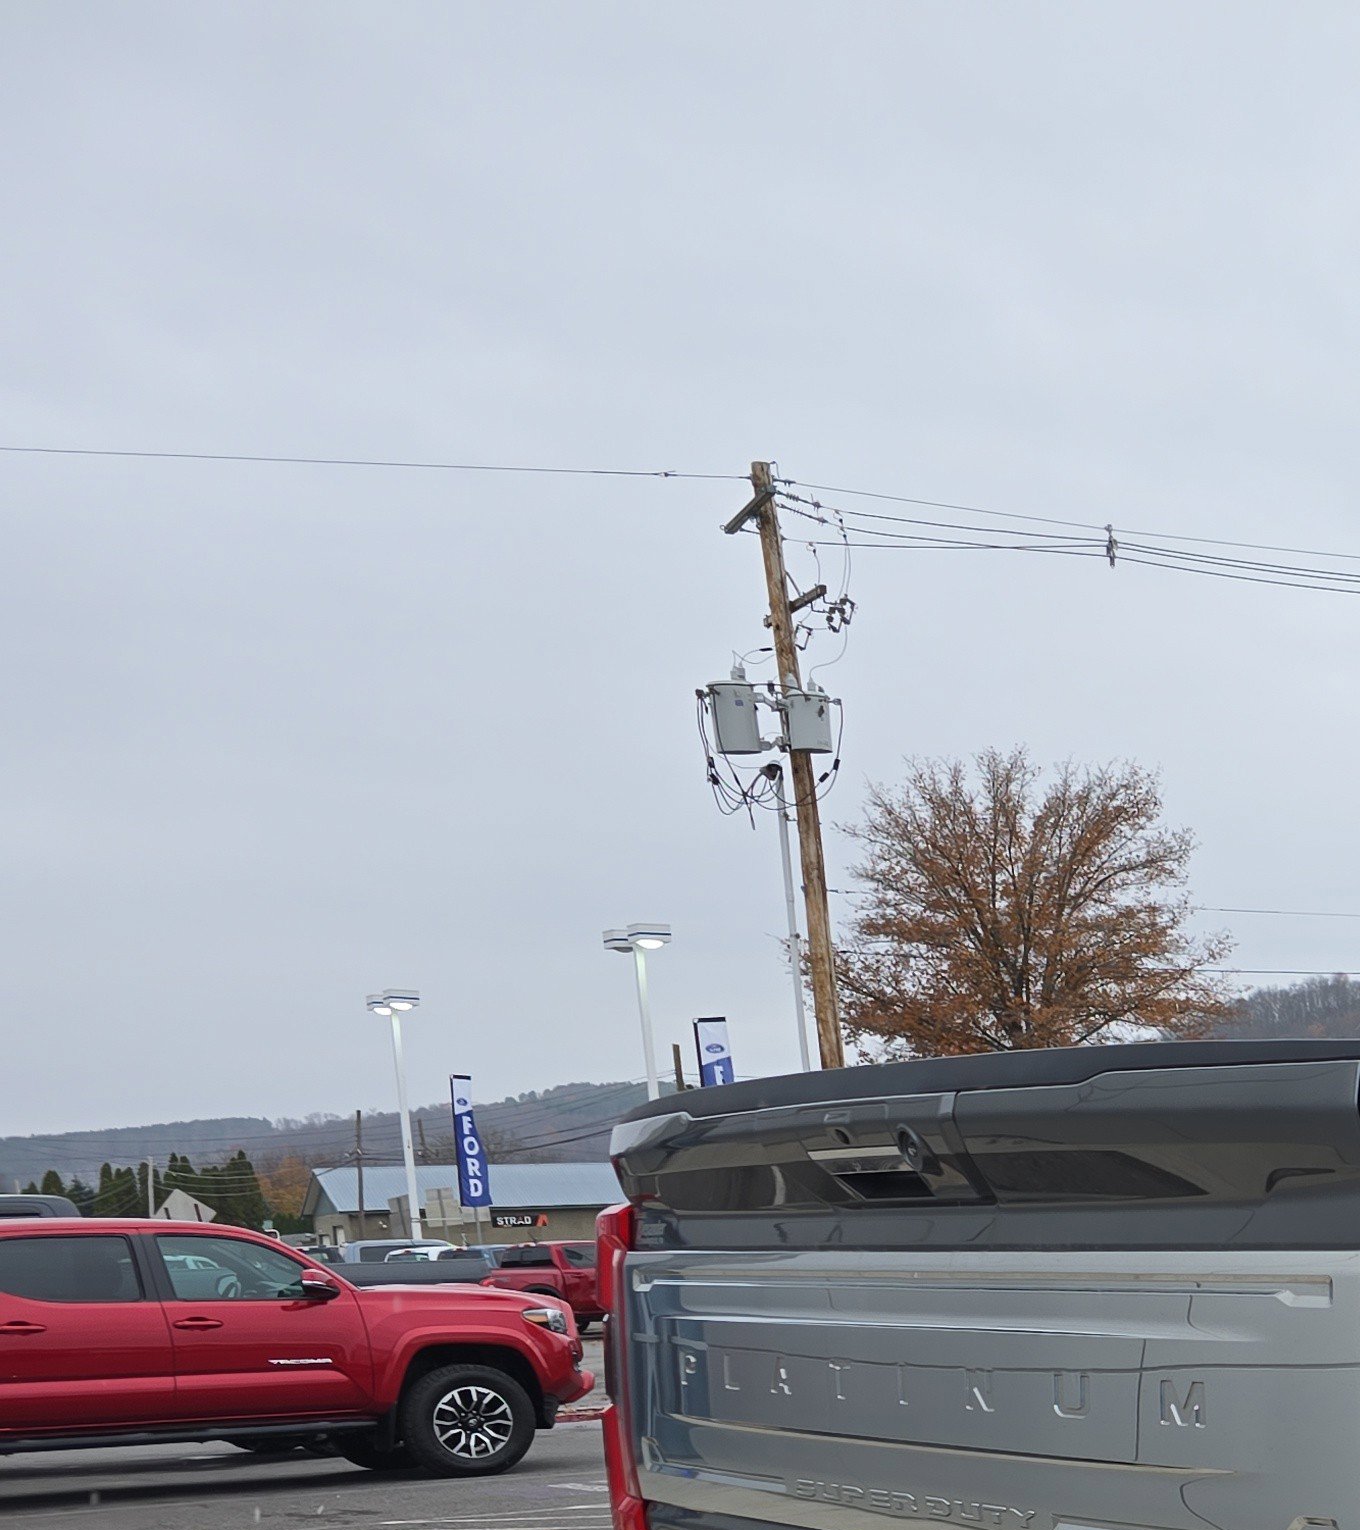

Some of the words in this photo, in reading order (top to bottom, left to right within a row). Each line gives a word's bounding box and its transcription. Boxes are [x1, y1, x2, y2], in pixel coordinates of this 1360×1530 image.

[461, 1115, 483, 1198] FORD
[496, 1216, 532, 1225] STRAD
[680, 1350, 1207, 1429] PLATINUM
[796, 1479, 918, 1512] SUPER
[925, 1495, 1036, 1529] DUTY
